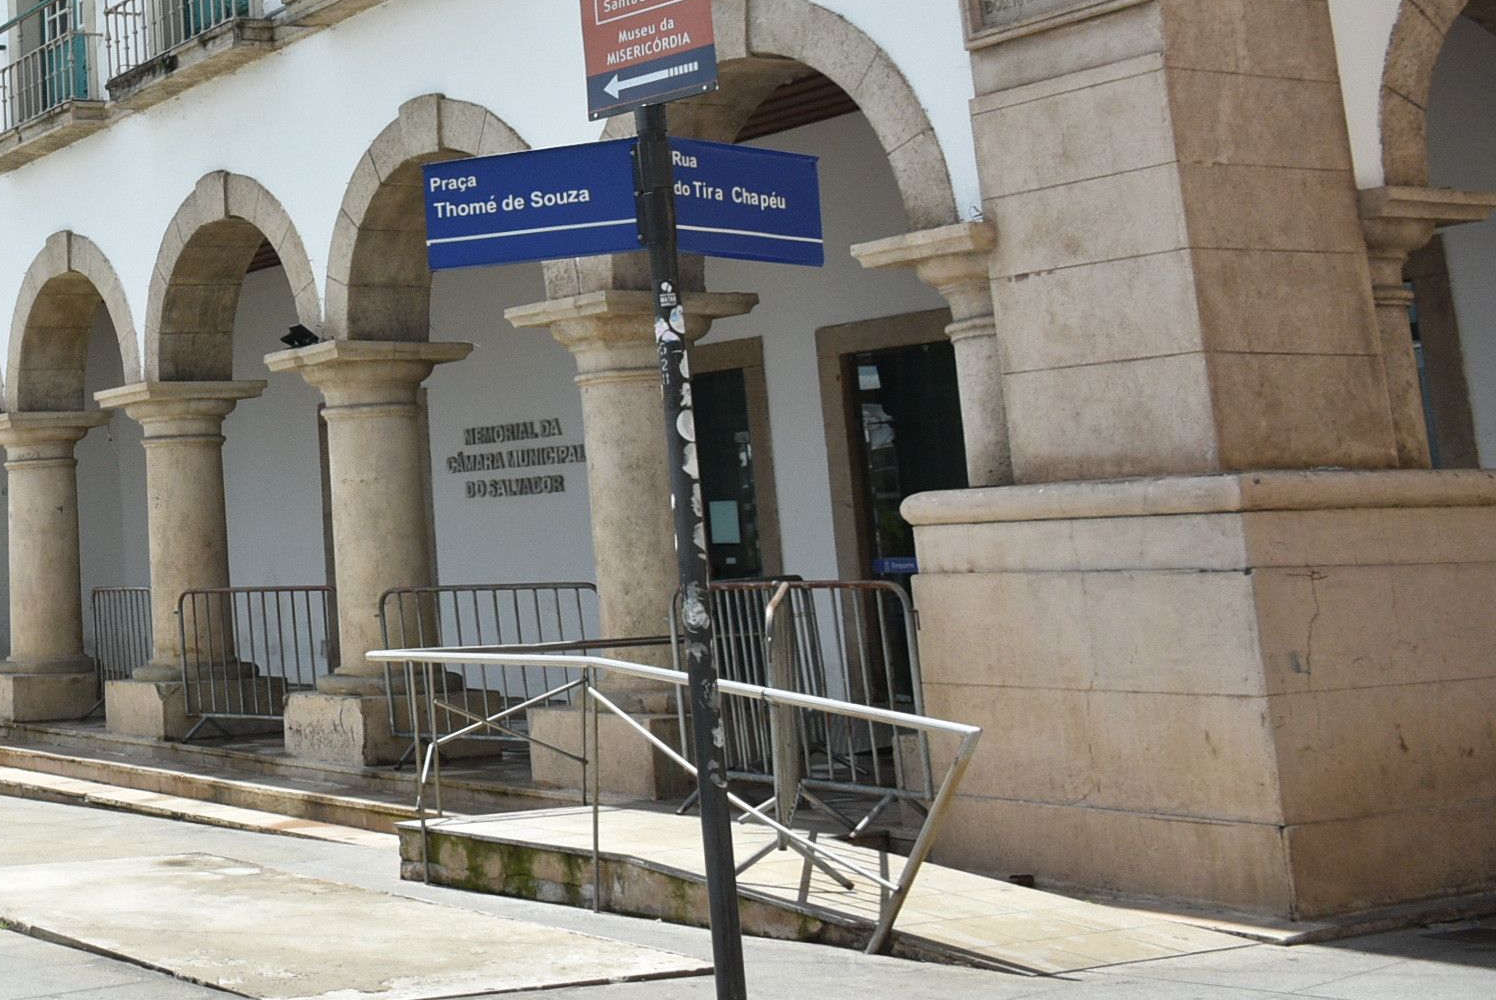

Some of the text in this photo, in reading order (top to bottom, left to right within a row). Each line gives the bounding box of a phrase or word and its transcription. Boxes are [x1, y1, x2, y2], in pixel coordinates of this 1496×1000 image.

[618, 17, 675, 43] Museu da
[606, 31, 691, 65] MISERICÓRDIA
[672, 151, 697, 168] Rua
[430, 175, 477, 193] Praça
[674, 180, 786, 210] do Tira Chapéu
[434, 187, 590, 219] Thomé de Souza
[464, 418, 562, 446] MEMORIAL DA
[447, 444, 586, 474] CÂMARA MUNICIPAL
[466, 475, 565, 499] DO SALVADOR
